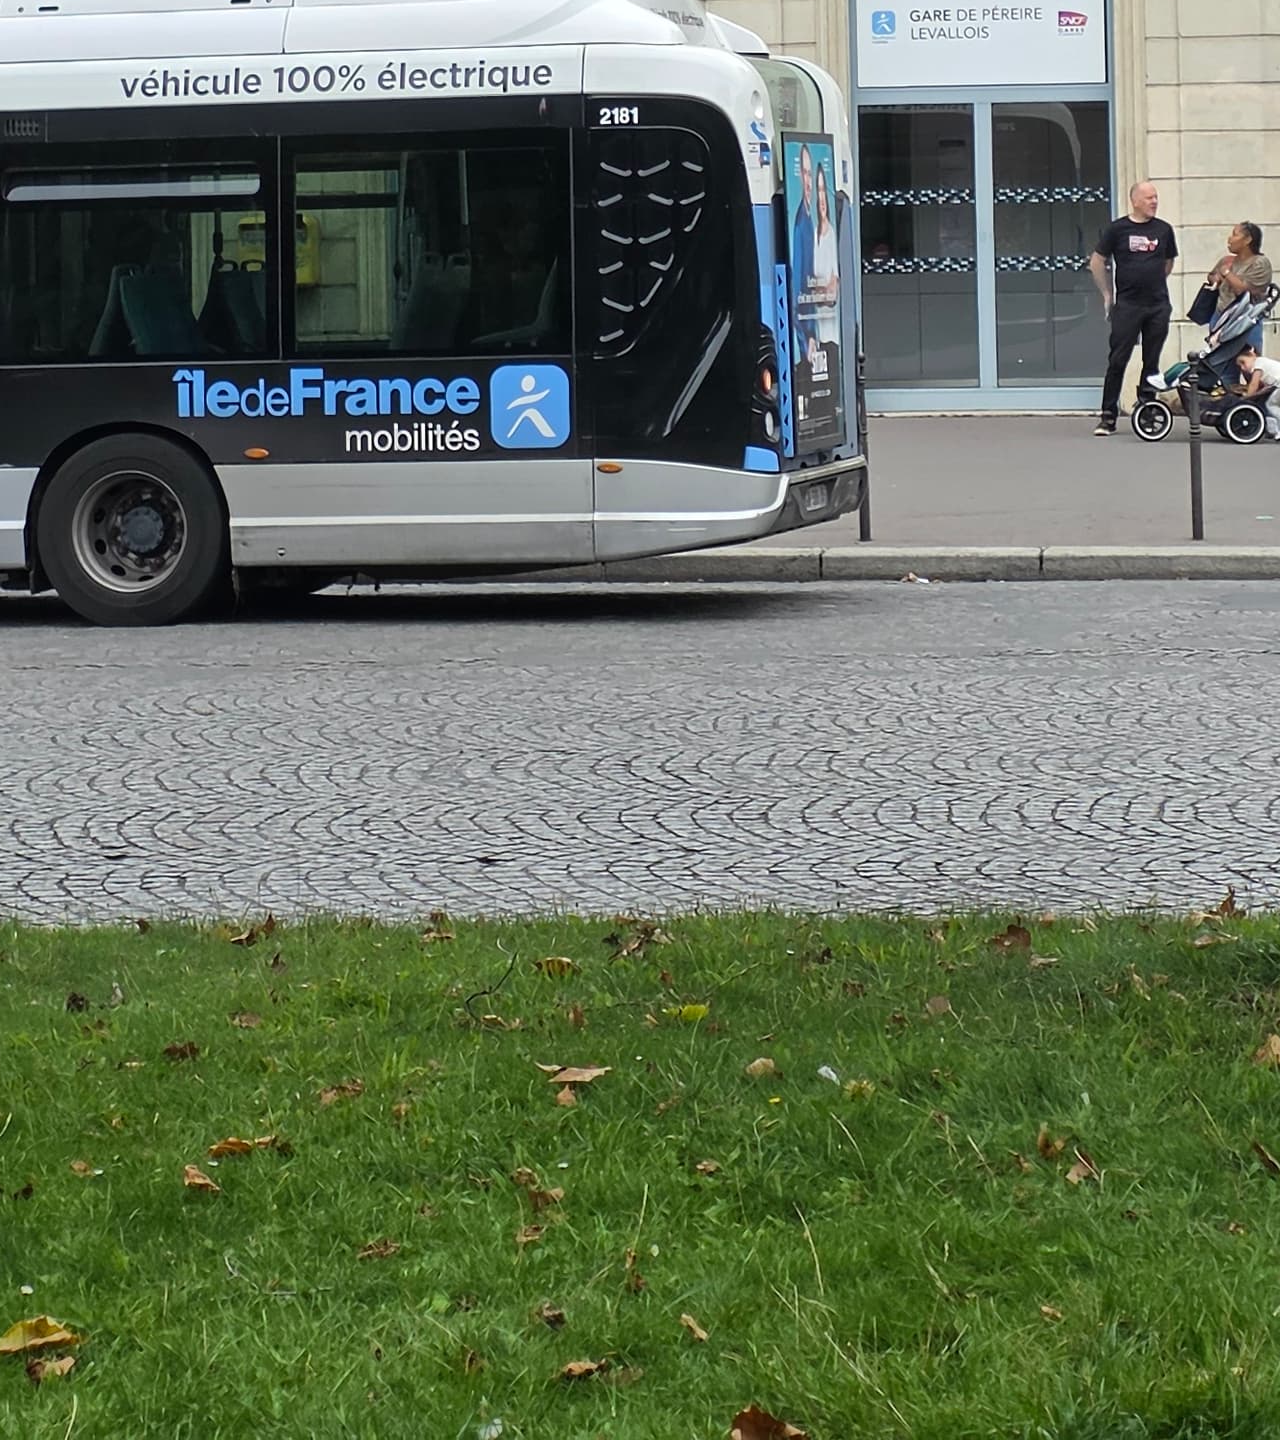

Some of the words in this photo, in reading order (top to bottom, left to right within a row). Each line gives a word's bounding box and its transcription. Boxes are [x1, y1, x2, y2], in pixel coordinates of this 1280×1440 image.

[909, 9, 952, 23] GARE
[956, 9, 977, 22] DE
[982, 5, 1043, 21] PÉREIRE
[911, 26, 990, 41] LEVALLOIS
[120, 68, 262, 99] véhicule
[273, 64, 367, 94] 100%
[376, 60, 553, 94] électrique
[599, 106, 639, 125] 2181
[344, 419, 481, 453] mobilités
